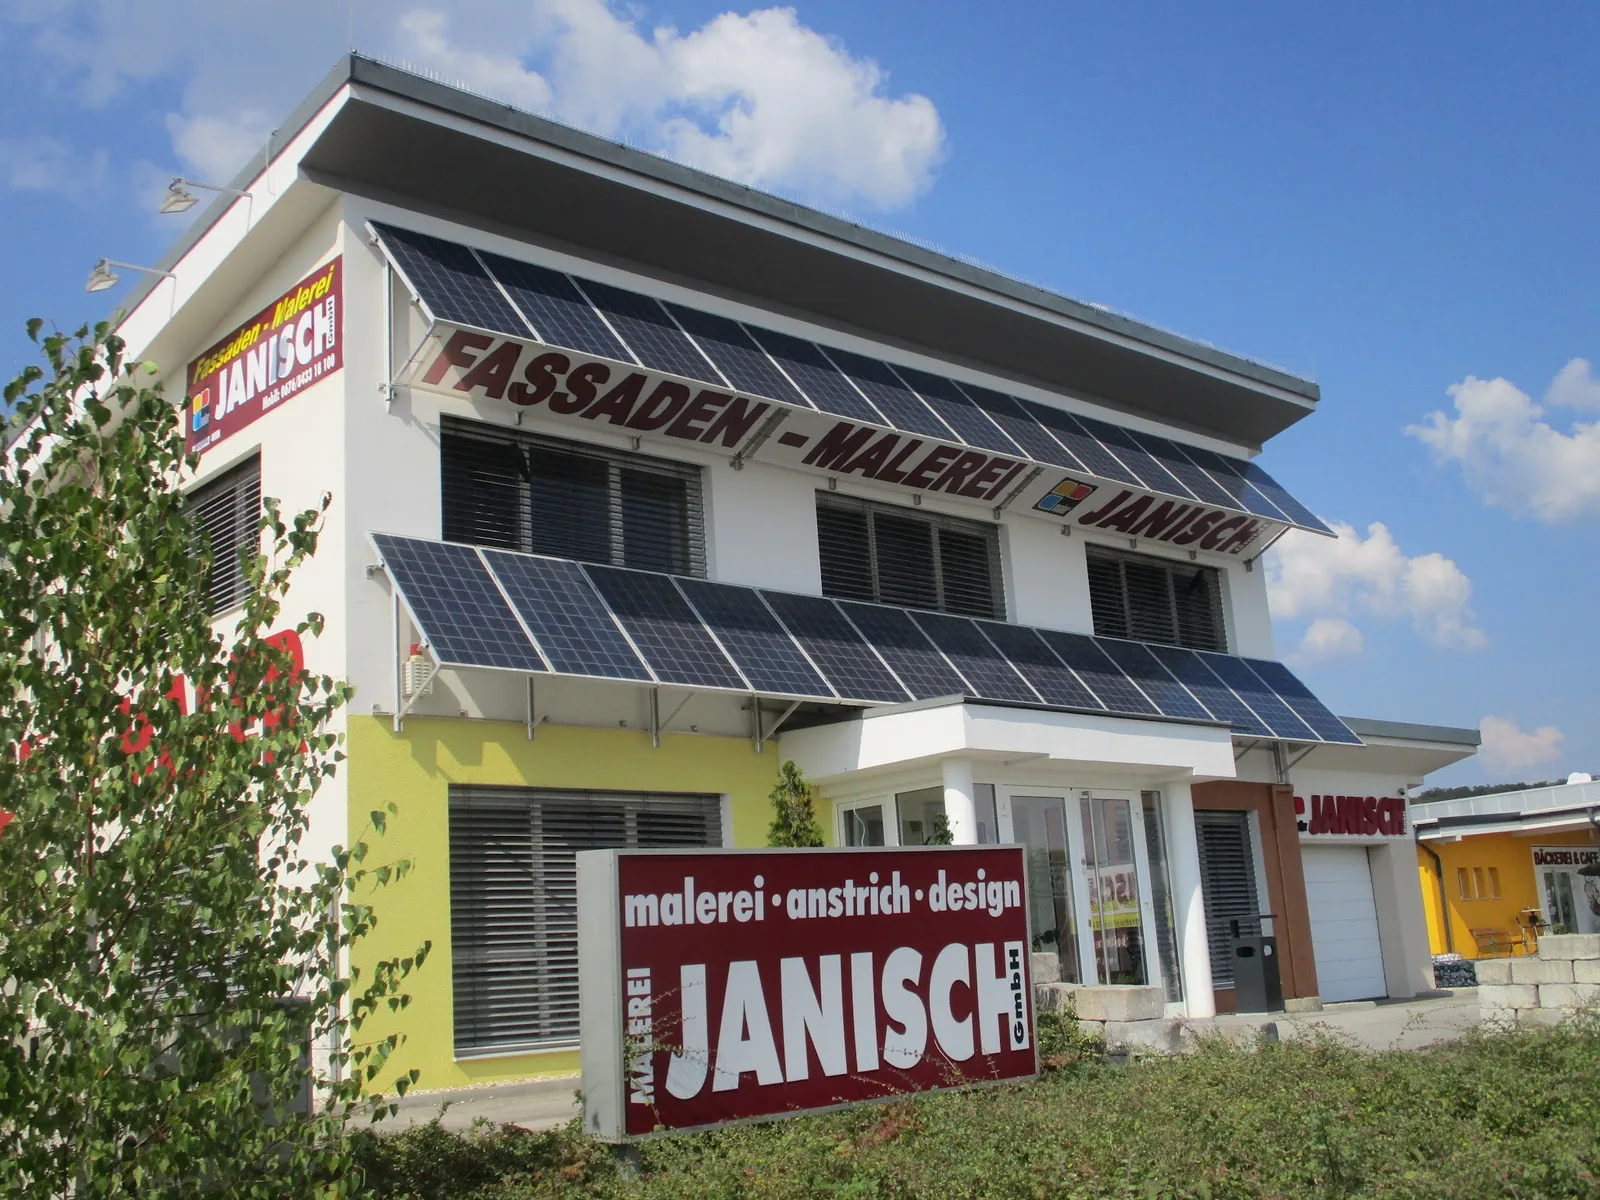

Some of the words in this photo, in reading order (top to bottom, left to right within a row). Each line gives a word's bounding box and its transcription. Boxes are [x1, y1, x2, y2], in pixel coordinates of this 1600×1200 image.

[193, 321, 261, 384] Fassaden
[271, 264, 335, 330] Malerei
[214, 294, 336, 420] JANISCH
[421, 329, 771, 448] FASSADEN
[801, 421, 1029, 501] MALEREI
[1078, 490, 1268, 554] JANISCH
[1308, 794, 1407, 836] JANISCH
[1533, 848, 1573, 865] BÄCKEREI
[625, 874, 765, 928] malerei
[786, 870, 911, 920] anstrich
[929, 867, 1021, 918] design
[626, 967, 656, 1104] MALEREI
[665, 940, 1030, 1101] JANISCH
[1009, 947, 1025, 1046] GmbH
